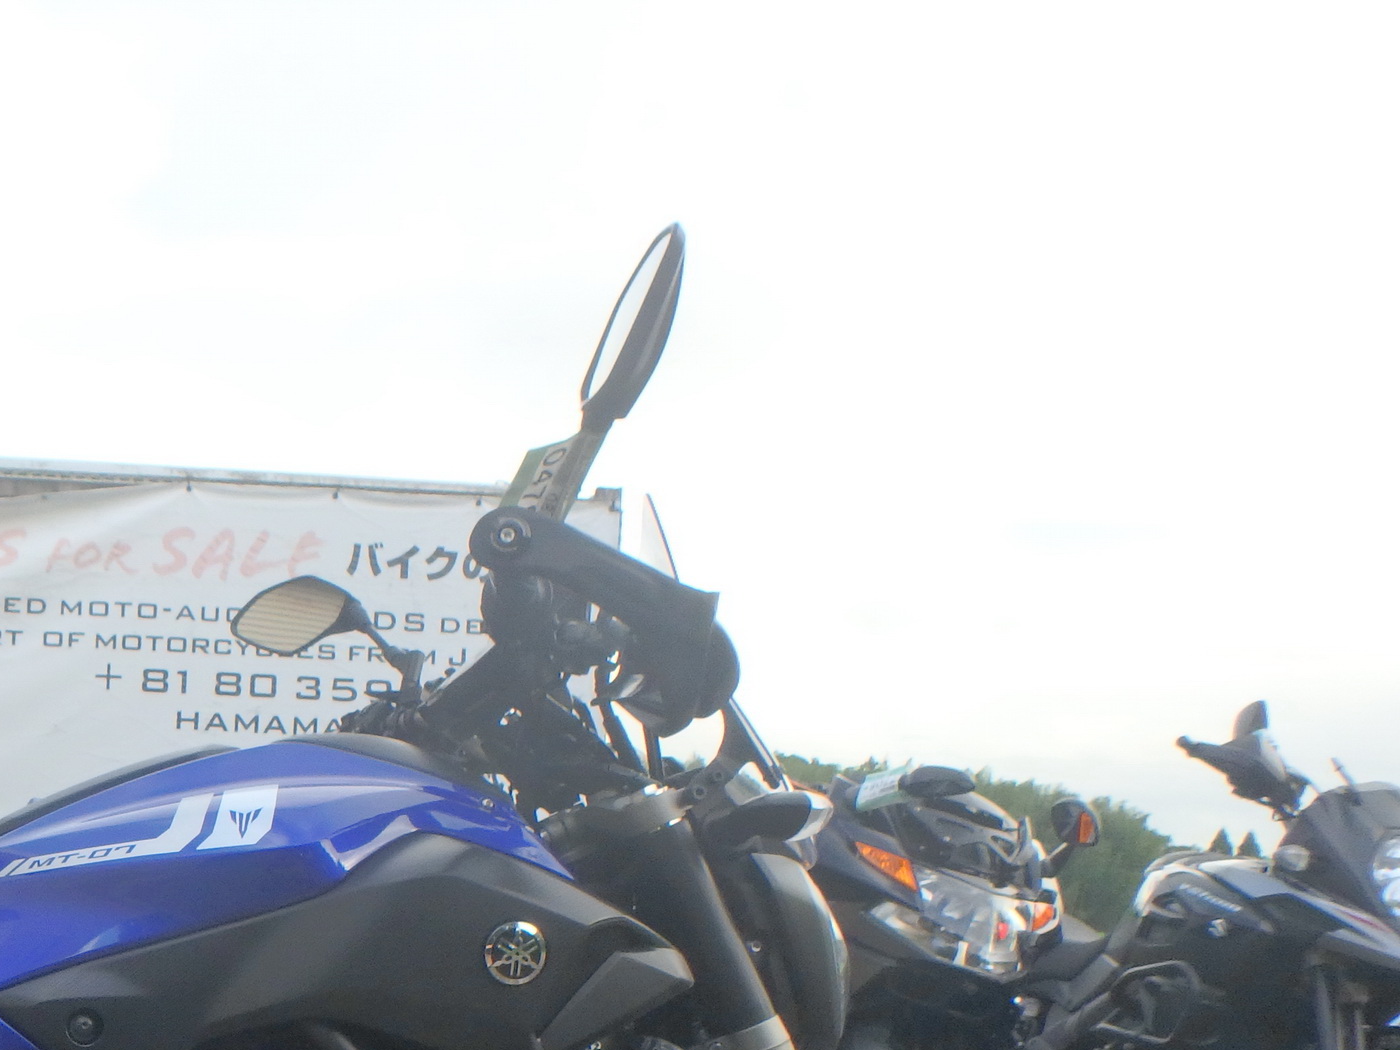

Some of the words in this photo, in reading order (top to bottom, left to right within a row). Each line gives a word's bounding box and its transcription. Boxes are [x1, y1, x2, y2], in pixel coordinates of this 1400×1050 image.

[45, 537, 140, 575] FOR
[151, 526, 325, 582] SALE
[60, 599, 241, 623] MOTO-AUC
[373, 611, 425, 632] DS
[440, 617, 482, 635] DE
[43, 631, 85, 648] OF
[95, 633, 336, 661] MOTORCYES
[349, 645, 436, 665] FRM
[214, 671, 277, 698] 80
[176, 710, 342, 735] HAMAMA
[28, 844, 137, 870] MT-07
